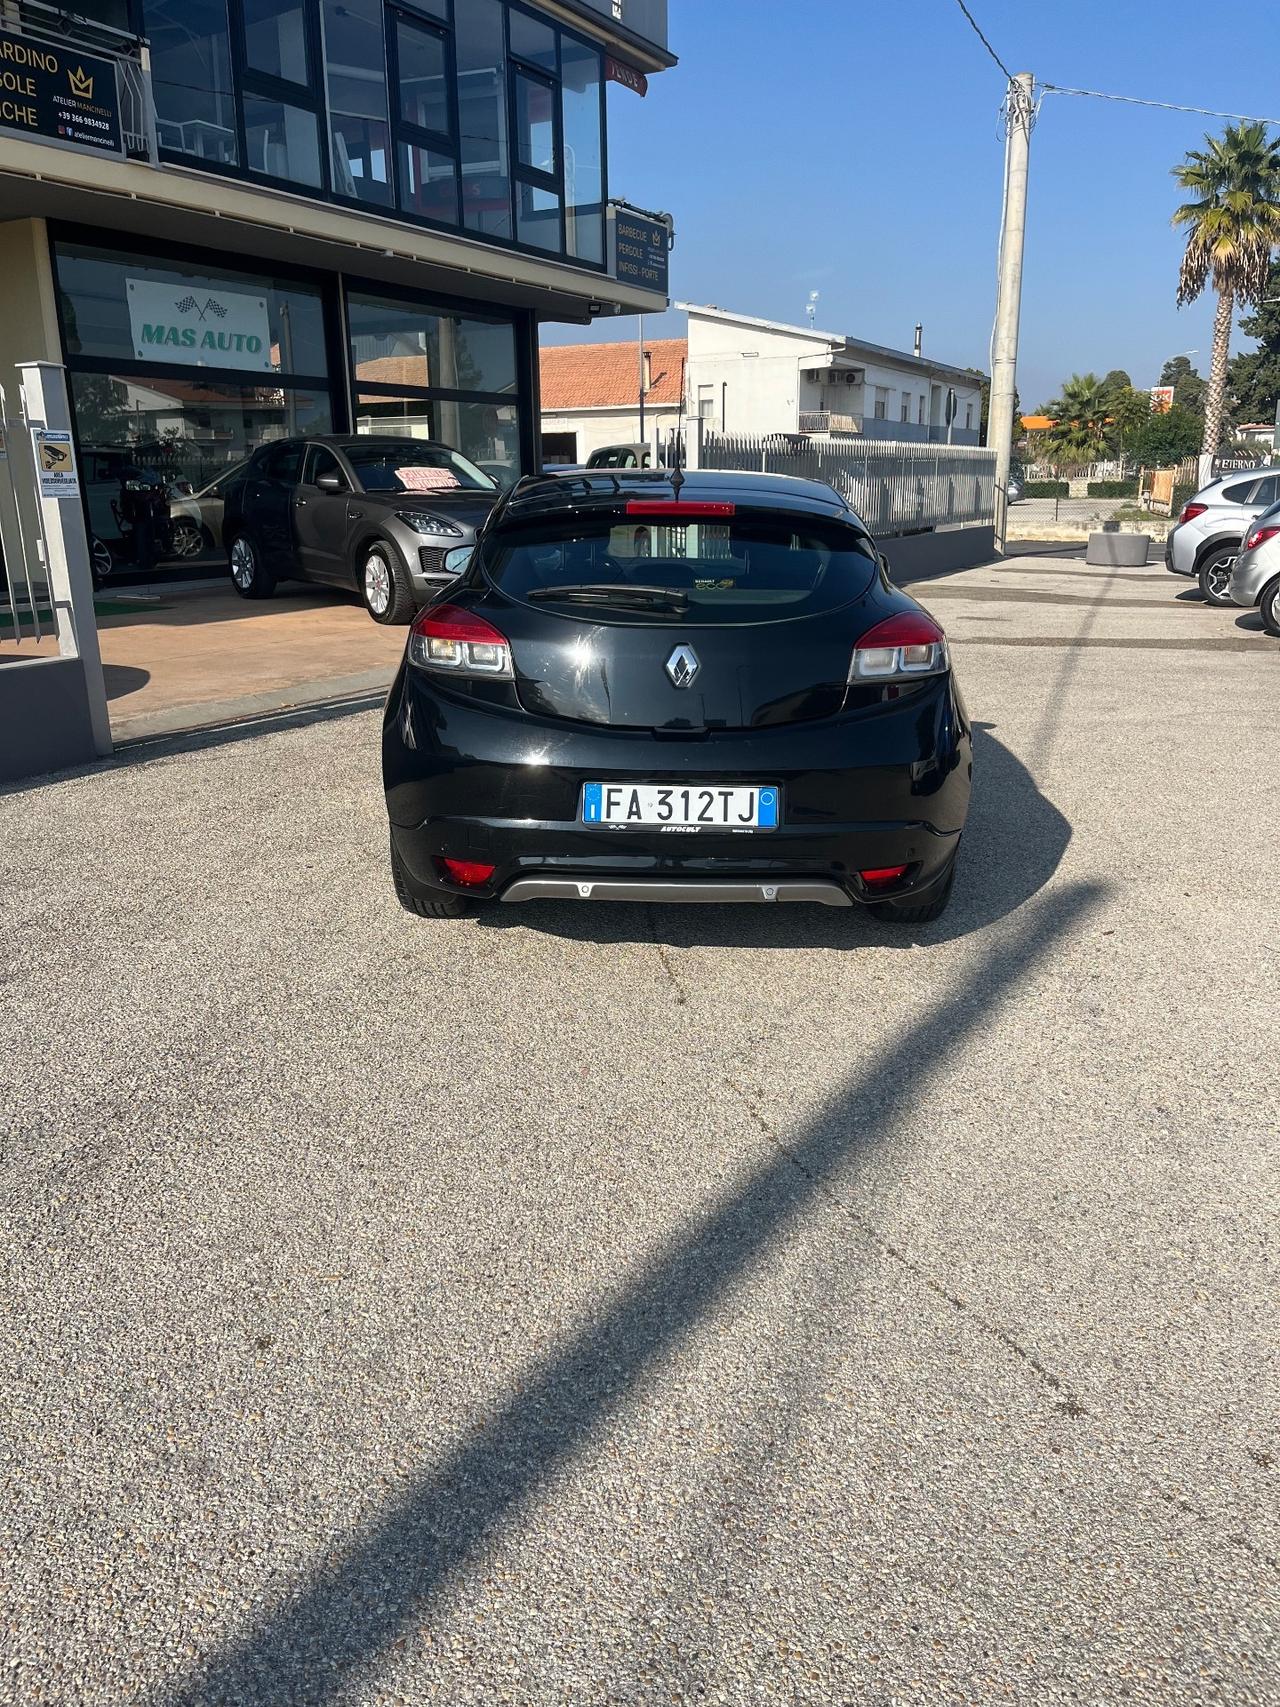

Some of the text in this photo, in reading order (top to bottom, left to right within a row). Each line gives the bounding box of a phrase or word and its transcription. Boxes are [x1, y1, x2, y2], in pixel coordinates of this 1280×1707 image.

[52, 95, 76, 108] ATELIER
[0, 101, 38, 127] CHE
[58, 111, 71, 121] +39
[617, 223, 647, 242] BARBECUE
[618, 242, 643, 259] PERGOLE
[641, 266, 659, 281] PORTE
[141, 323, 262, 353] MAS AUTO
[606, 787, 643, 820] FA
[656, 789, 754, 823] 312TJ
